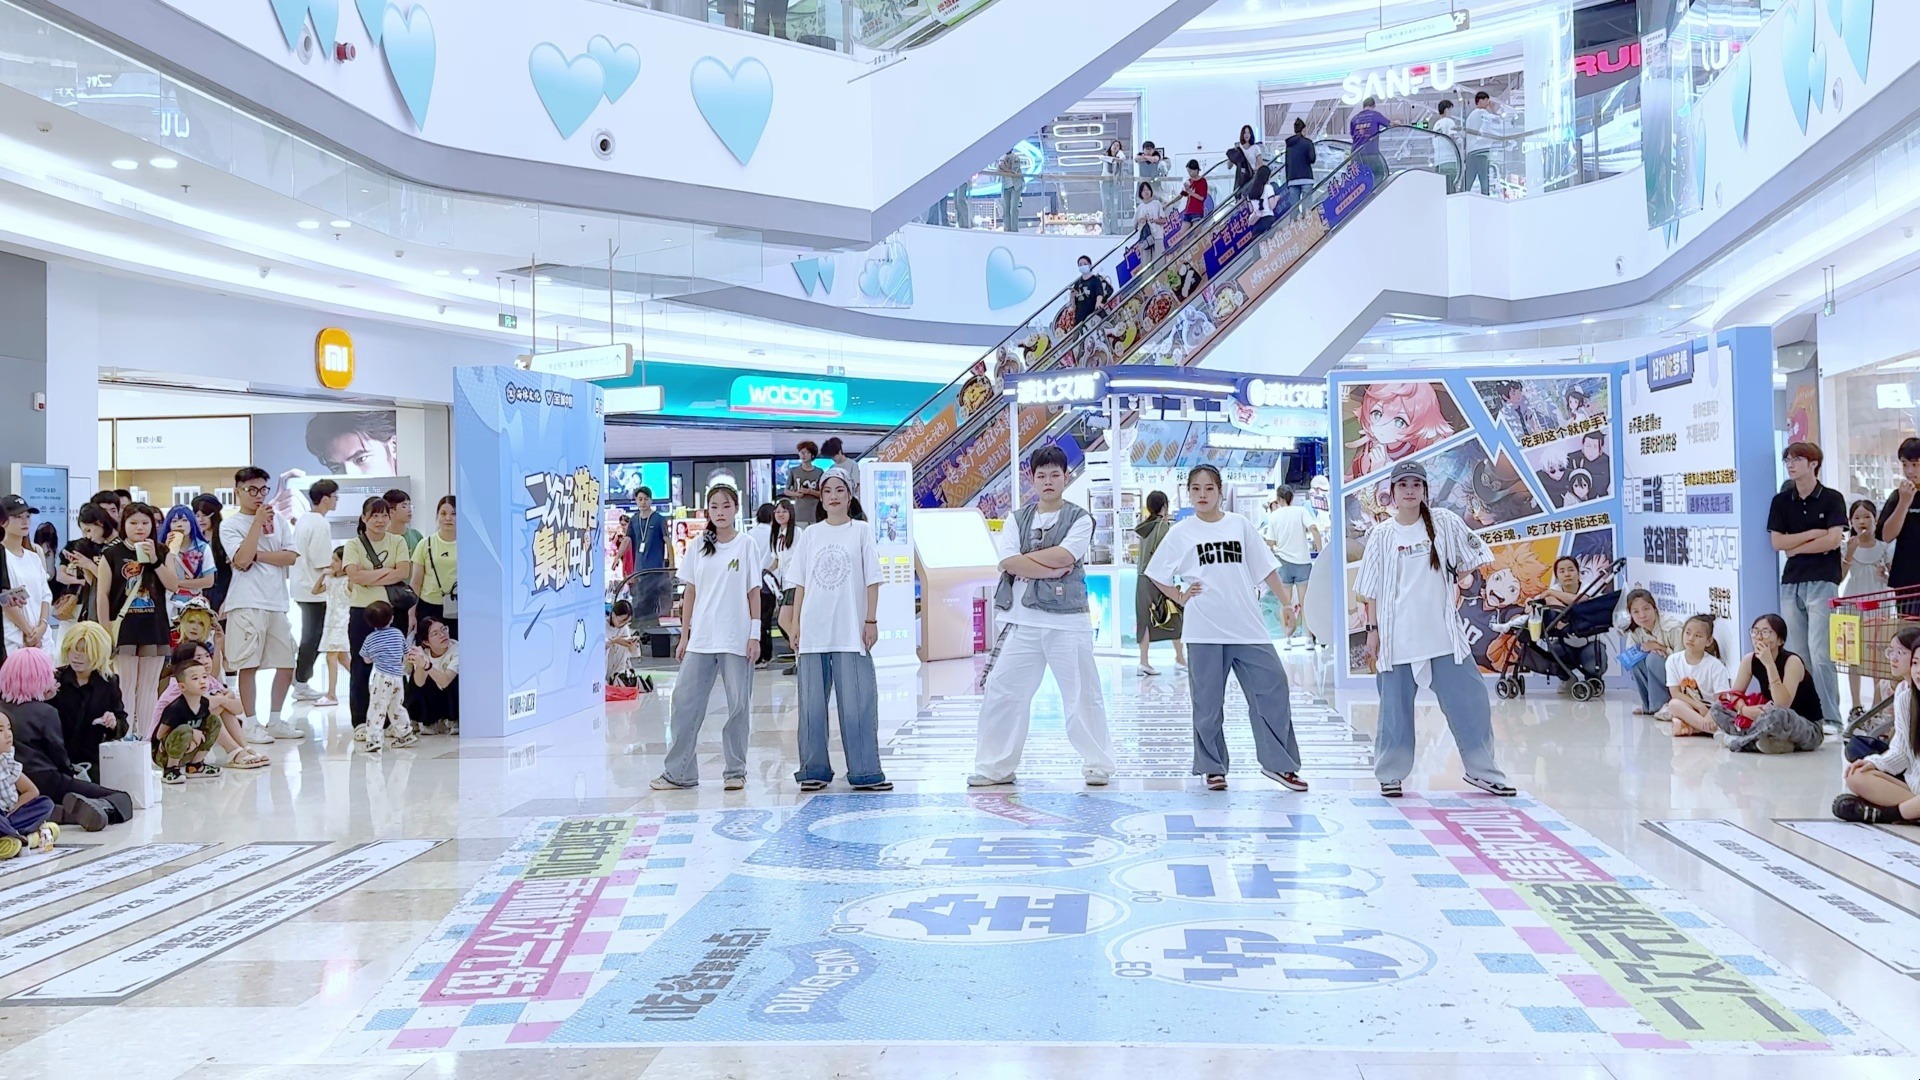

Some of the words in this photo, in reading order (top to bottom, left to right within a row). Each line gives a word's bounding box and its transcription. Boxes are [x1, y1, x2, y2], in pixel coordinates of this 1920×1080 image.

[1341, 60, 1455, 105] SANFU
[749, 384, 834, 408] watsons
[531, 526, 594, 595] 集散中心
[1643, 525, 1739, 571] 这谷确实非吃不可
[1436, 810, 1606, 880] 集散中心
[1165, 863, 1372, 898] 元
[768, 949, 862, 1013] DIMENSION
[1158, 929, 1417, 981] 次
[1520, 883, 1806, 1031] 二次元游客
